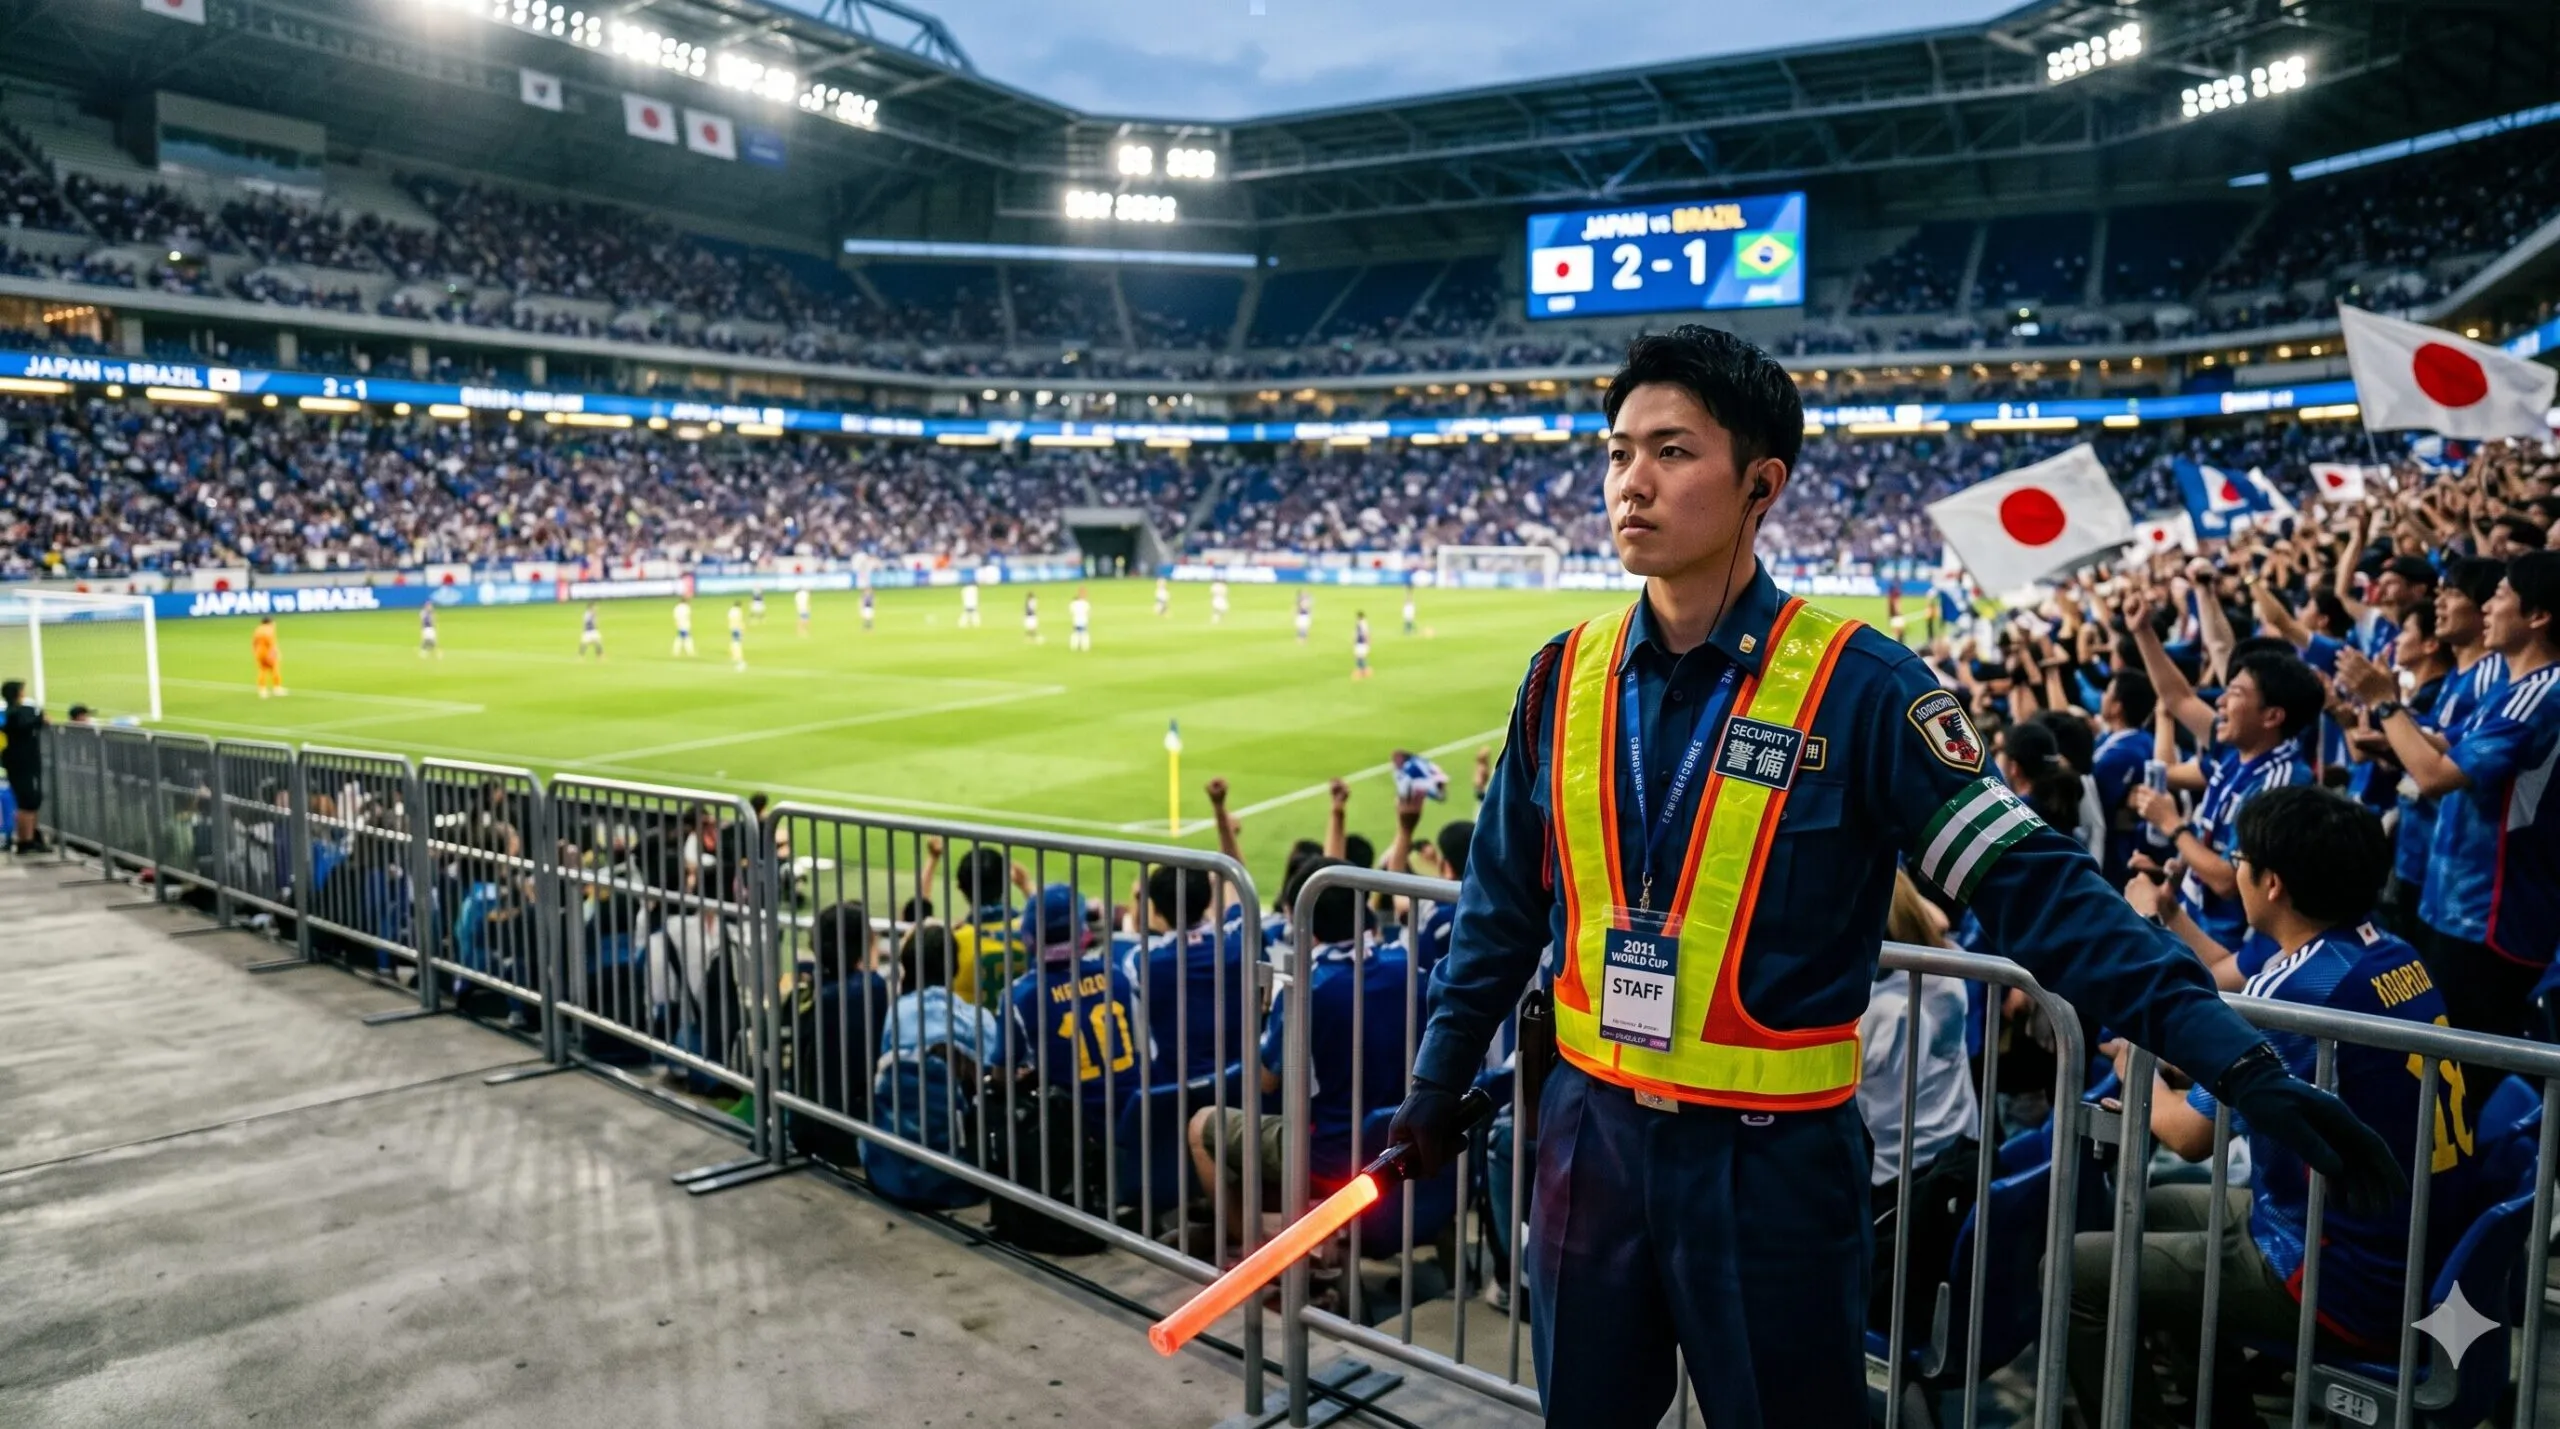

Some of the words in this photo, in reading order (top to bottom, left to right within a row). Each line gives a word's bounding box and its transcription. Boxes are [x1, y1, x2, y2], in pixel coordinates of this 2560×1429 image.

[1581, 212, 1648, 241] JAPAN
[1672, 203, 1747, 234] BRAZIL
[1611, 243, 1643, 290] 2
[1682, 238, 1707, 286] 1
[24, 355, 101, 381] JAPAN
[127, 362, 203, 388] BRAZIL
[353, 378, 368, 400] 1
[189, 591, 270, 616] JAPAN
[297, 587, 380, 611] BRAZIL
[1731, 723, 1794, 747] SECURITY
[1726, 738, 1788, 779] 警備
[1611, 951, 1647, 966] WORLD
[1648, 957, 1669, 969] CUP
[1623, 939, 1657, 957] 2011
[1612, 977, 1664, 1001] STAFF
[1057, 1000, 1134, 1081] 10
